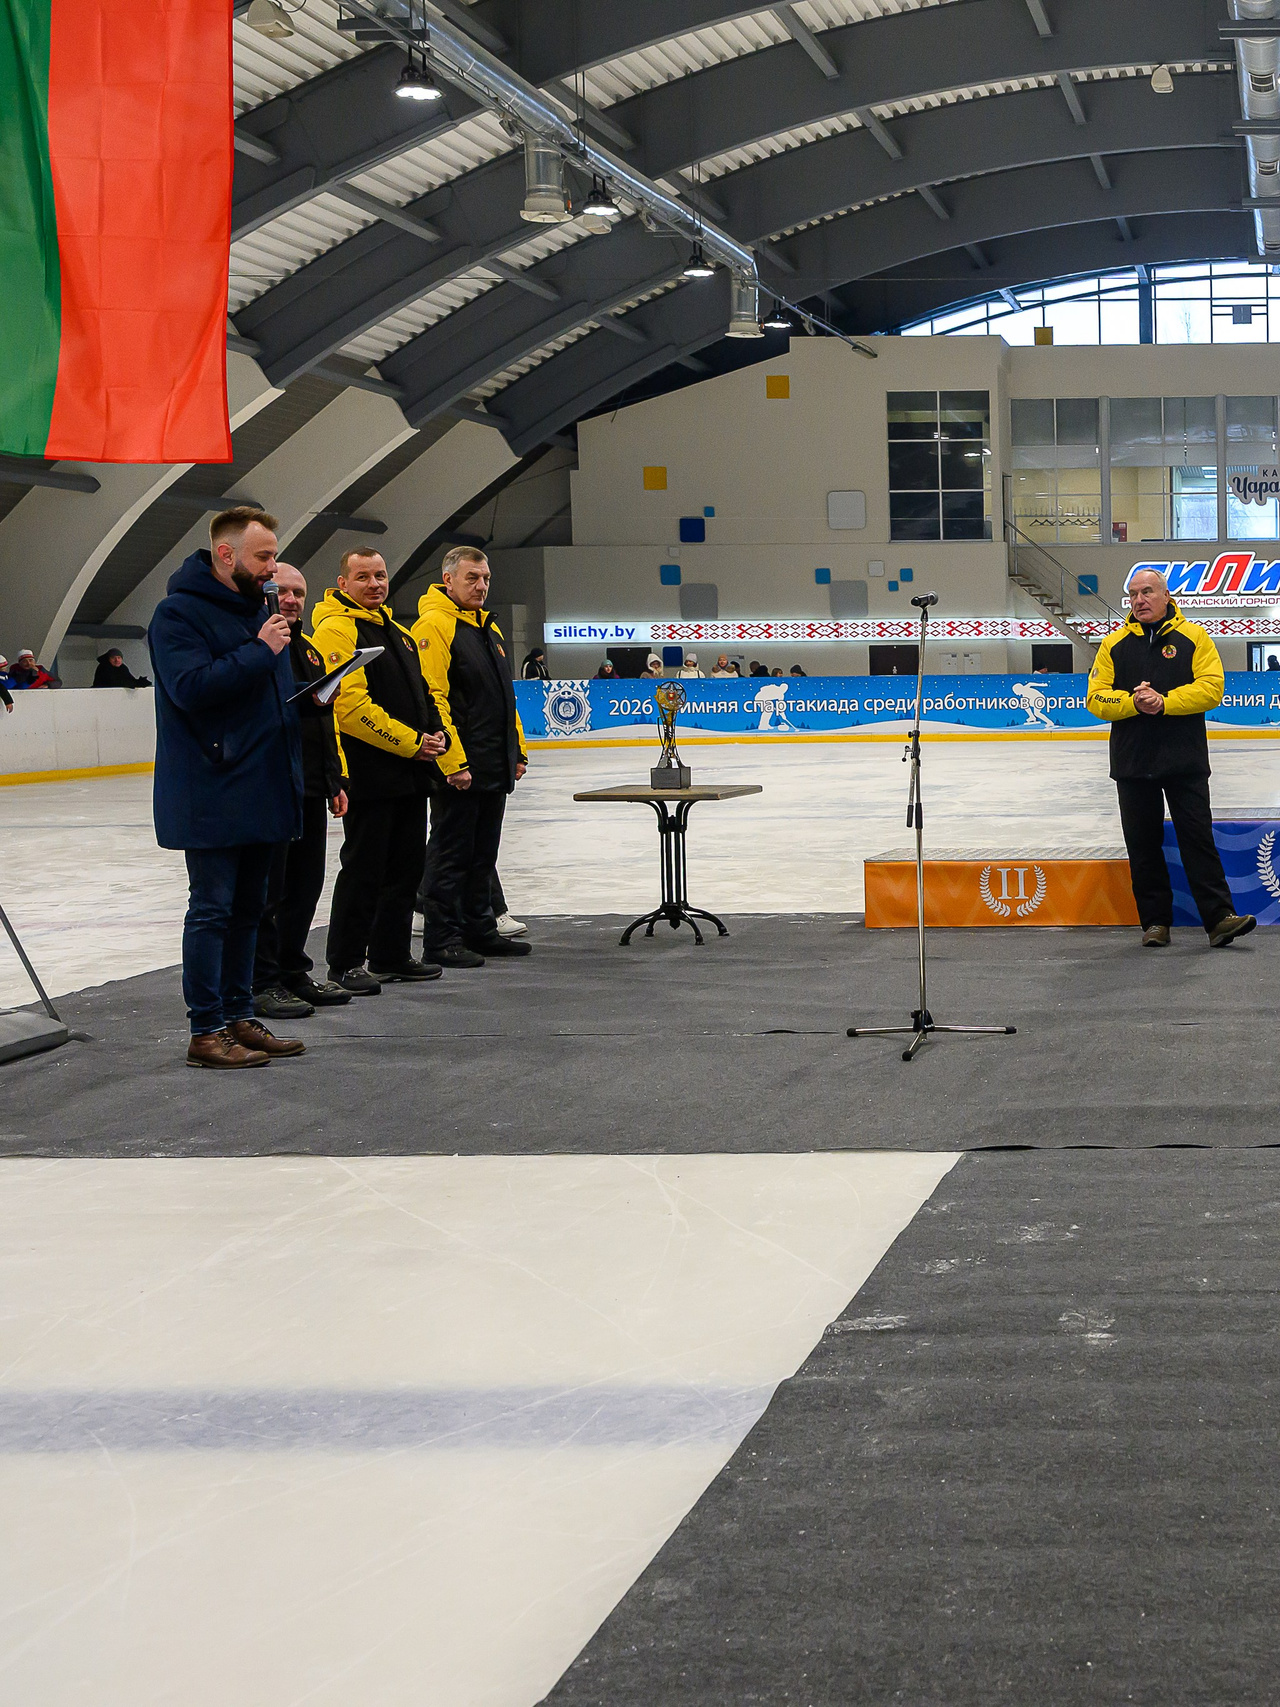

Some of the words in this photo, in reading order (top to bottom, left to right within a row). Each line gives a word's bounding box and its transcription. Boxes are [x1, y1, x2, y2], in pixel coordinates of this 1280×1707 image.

[1123, 596, 1238, 606] РИКАНСКИЙ
[553, 625, 636, 640] silichy.by
[608, 698, 654, 716] 2026
[679, 700, 738, 714] имняя
[742, 694, 860, 716] спартакиада
[863, 697, 919, 715] среди
[922, 690, 1030, 715] работников
[1033, 695, 1087, 713] орган
[1094, 693, 1121, 704] BEARUS
[360, 715, 401, 746] BELARUS
[996, 867, 1030, 899] II
